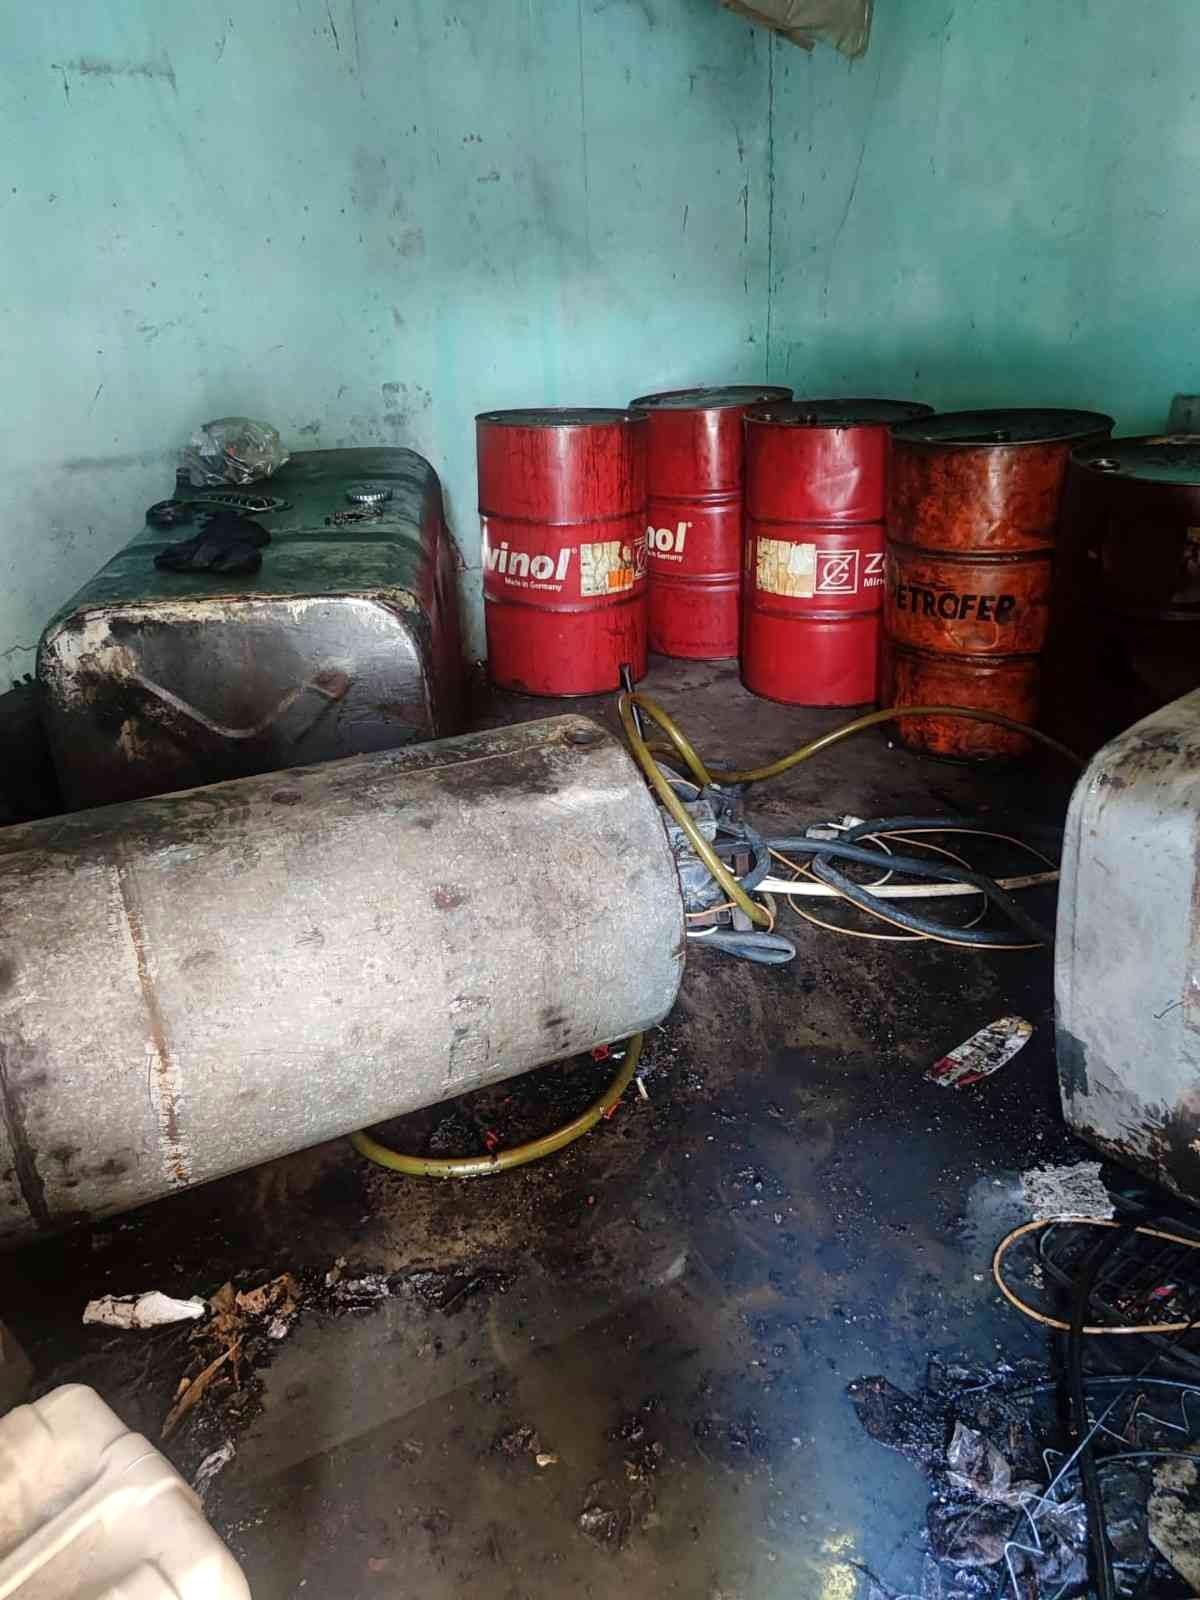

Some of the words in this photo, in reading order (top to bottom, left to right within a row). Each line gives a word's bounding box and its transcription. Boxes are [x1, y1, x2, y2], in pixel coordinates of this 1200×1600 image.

[484, 541, 571, 580] vinol
[529, 580, 563, 592] Germany
[895, 584, 1017, 624] ETROFER
